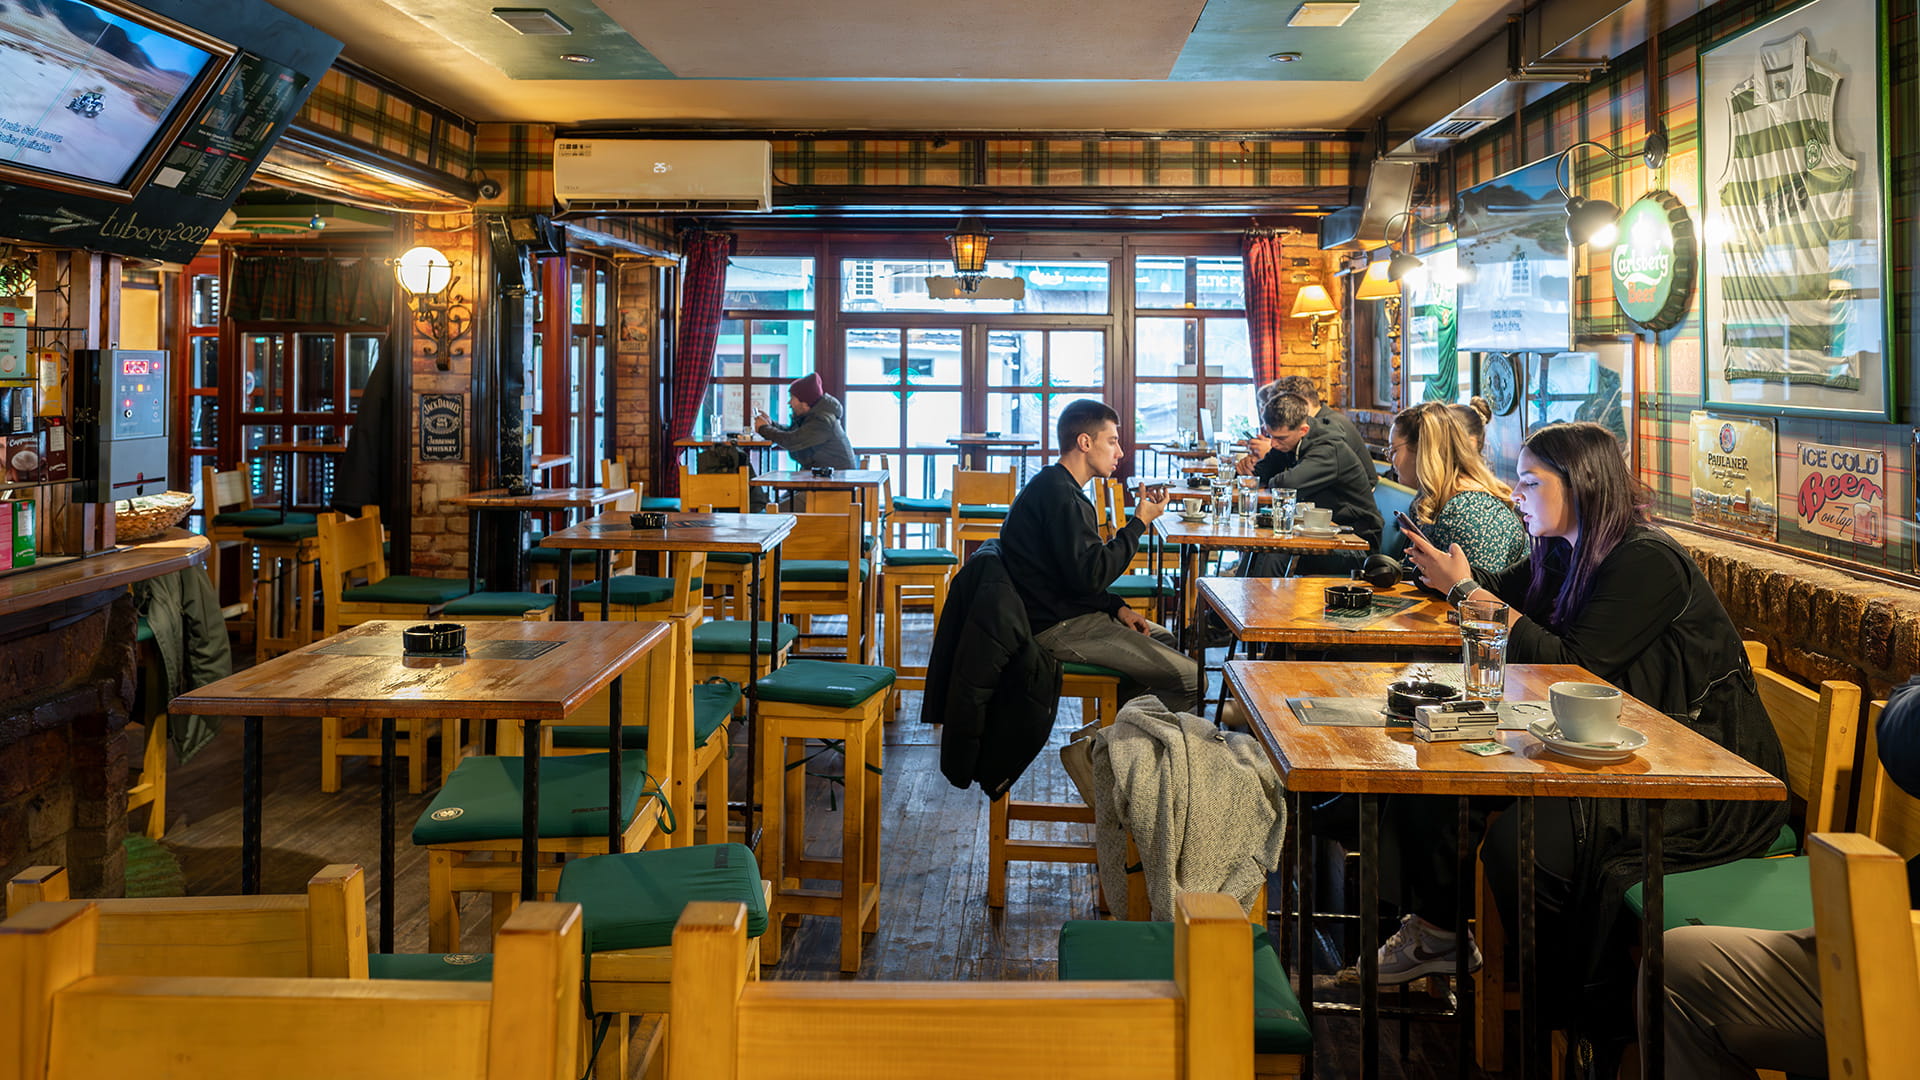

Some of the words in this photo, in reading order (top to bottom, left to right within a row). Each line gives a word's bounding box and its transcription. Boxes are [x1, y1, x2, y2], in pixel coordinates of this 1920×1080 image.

[1613, 245, 1670, 281] Carlsberg
[1195, 275, 1229, 288] ELTIC
[1628, 281, 1657, 304] Beer
[1707, 452, 1750, 472] PAULANER
[1801, 446, 1828, 468] ICE
[1831, 450, 1879, 475] COLD
[1798, 472, 1883, 524] Beer
[1821, 512, 1836, 524] on
[1834, 505, 1854, 537] Tap
